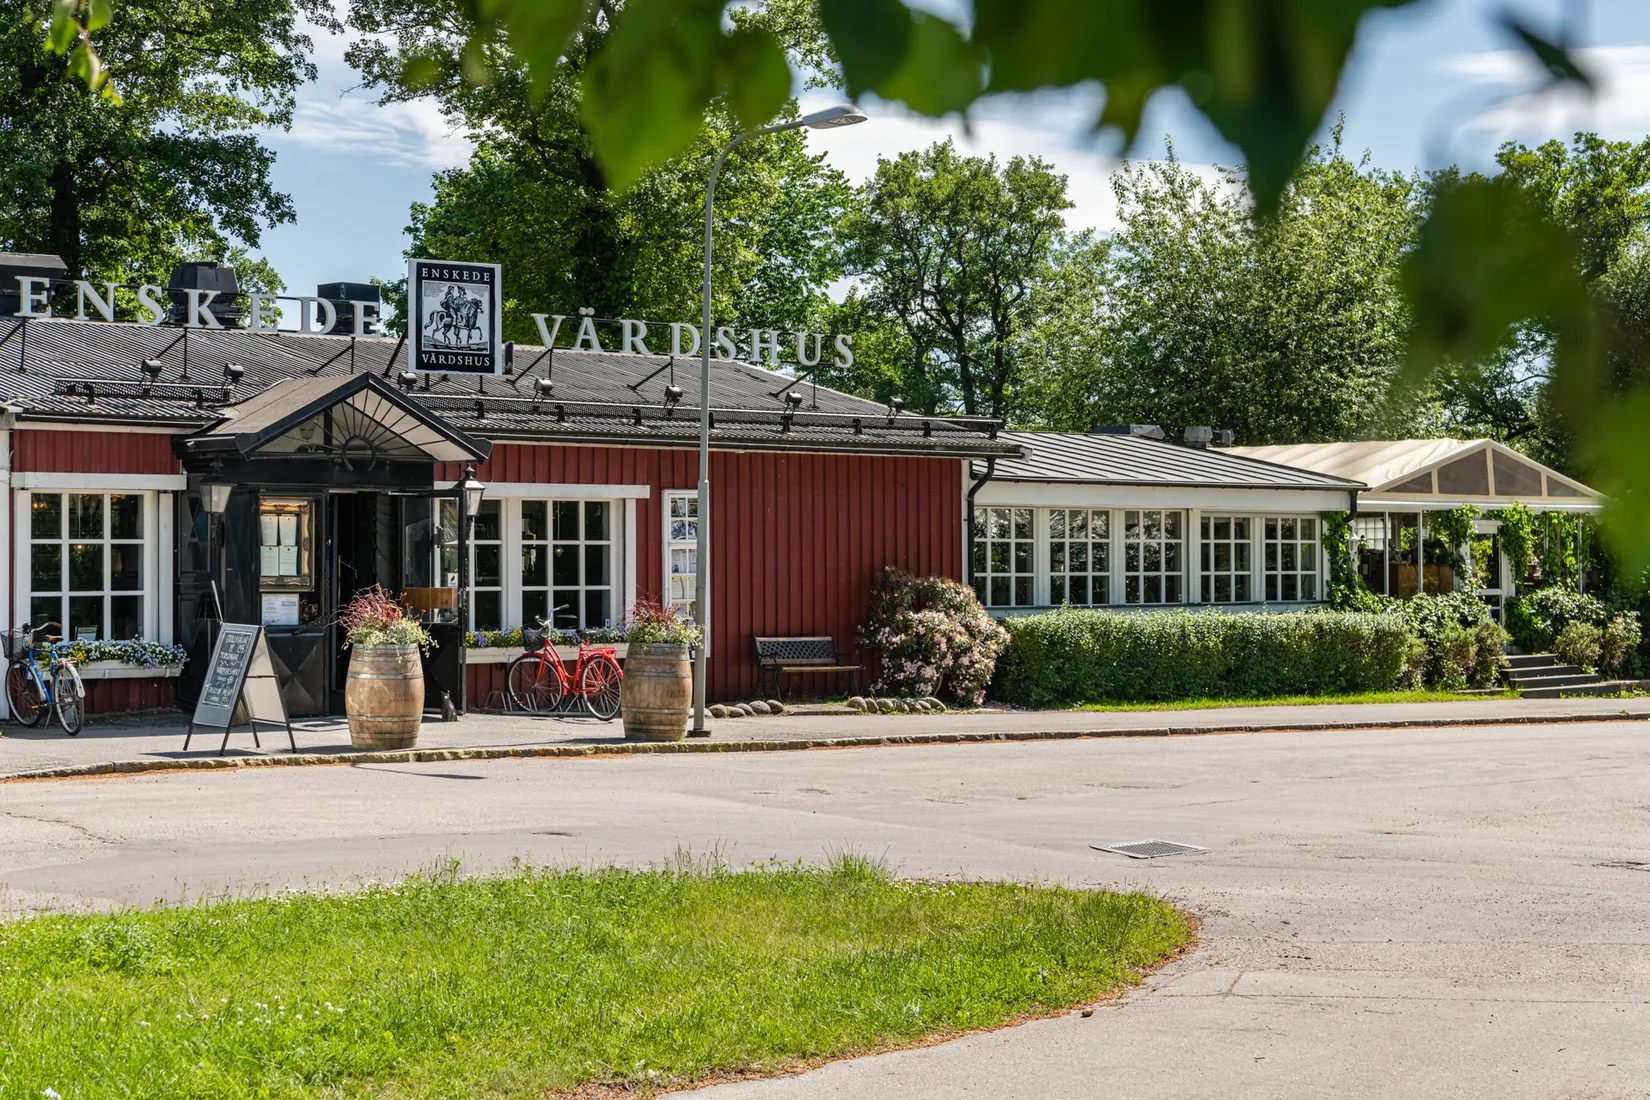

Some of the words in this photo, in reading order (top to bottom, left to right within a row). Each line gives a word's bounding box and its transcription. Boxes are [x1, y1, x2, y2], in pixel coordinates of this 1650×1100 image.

[421, 268, 490, 282] ENSKEDE
[13, 275, 381, 339] ENSKEDE
[531, 307, 854, 368] VÄRDSHUS
[421, 352, 490, 366] VÄRDSHUS
